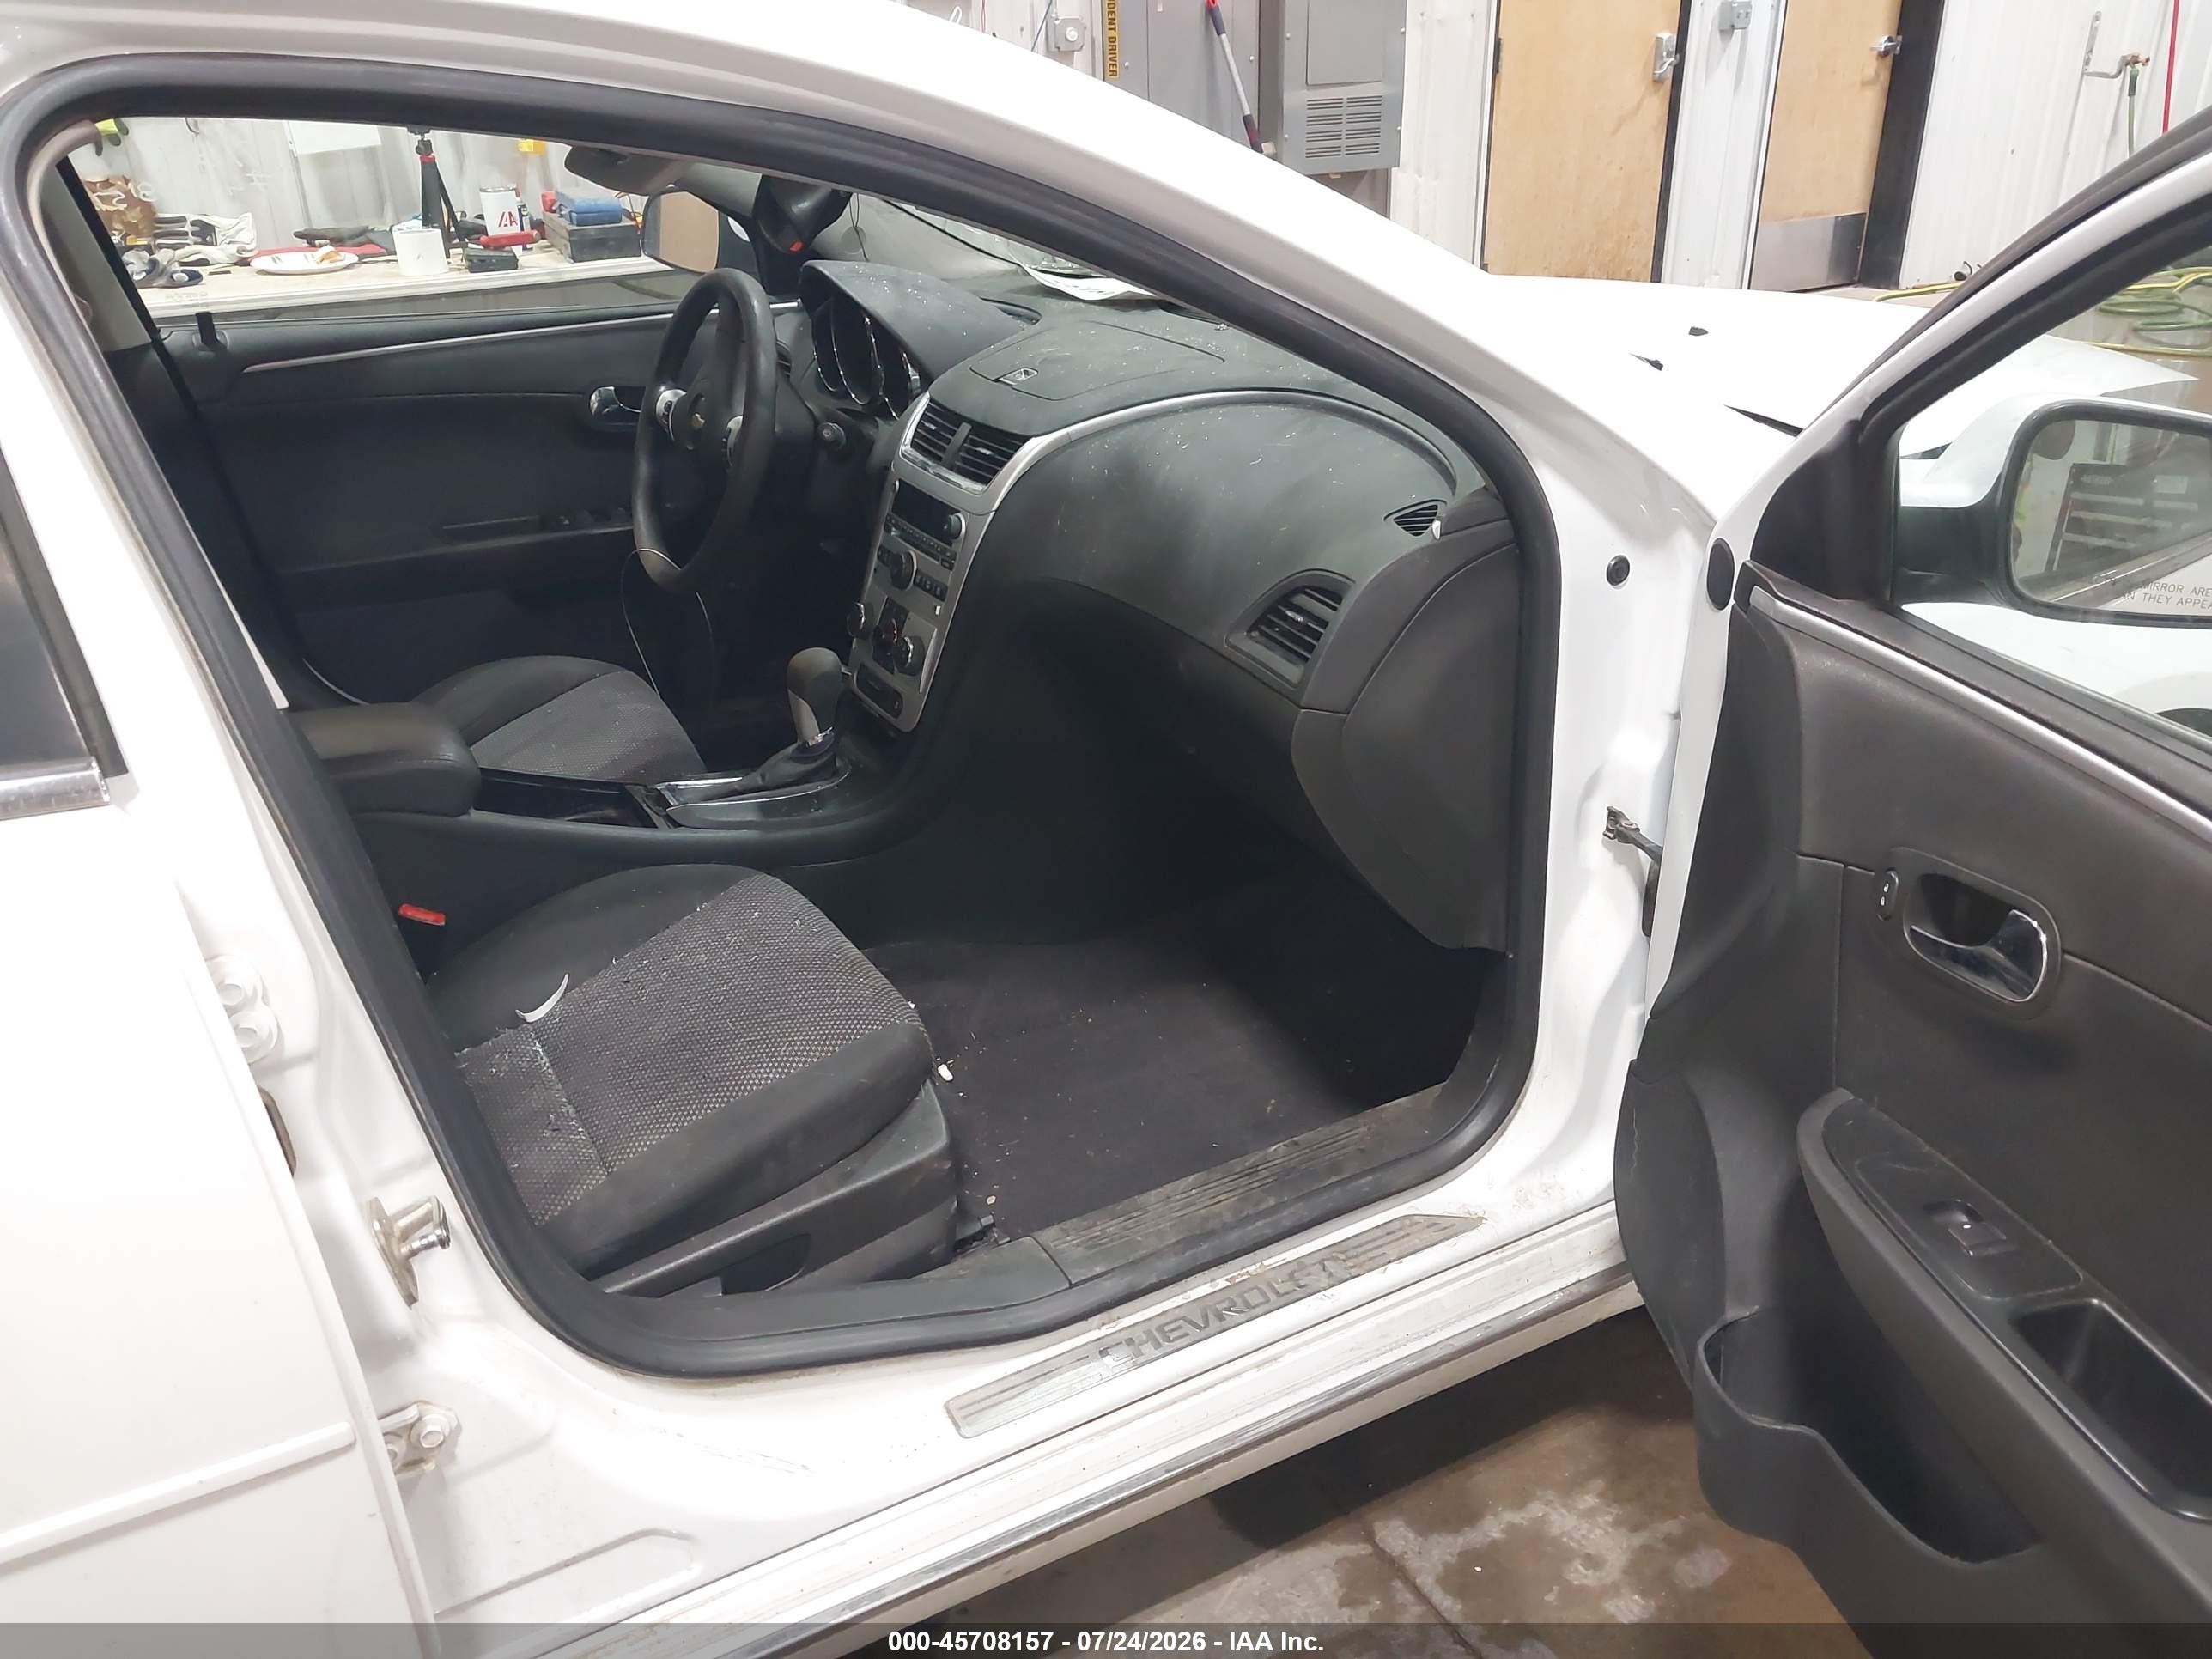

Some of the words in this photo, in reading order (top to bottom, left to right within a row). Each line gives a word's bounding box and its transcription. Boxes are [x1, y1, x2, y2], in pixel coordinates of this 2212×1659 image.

[1107, 0, 1116, 32] DENT
[1108, 36, 1118, 77] DRIVER
[2142, 592, 2172, 605] THEY
